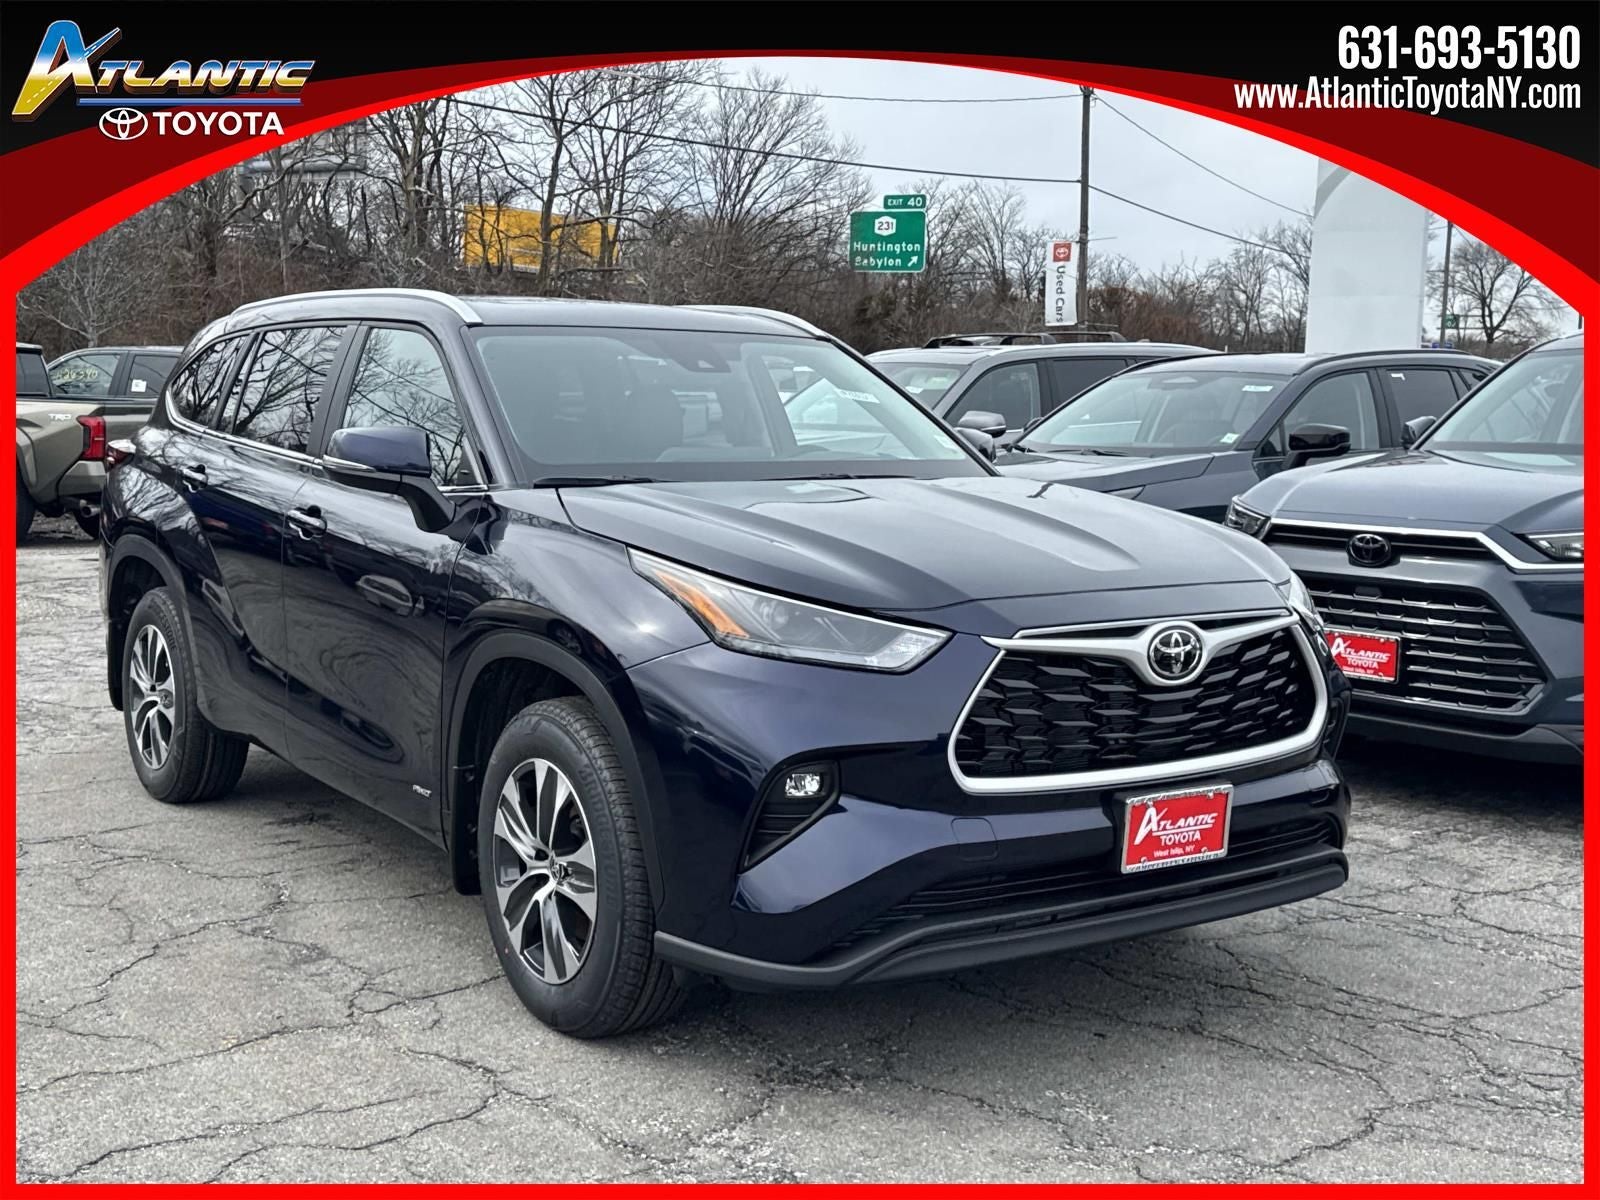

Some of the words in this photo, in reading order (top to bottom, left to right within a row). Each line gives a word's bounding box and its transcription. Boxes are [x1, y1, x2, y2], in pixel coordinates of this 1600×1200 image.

[887, 198, 903, 206] EXIT
[907, 196, 923, 207] 40
[877, 221, 894, 231] 231
[853, 241, 921, 255] Huntington
[854, 256, 902, 269] Babylon
[1055, 265, 1067, 295] Used
[1055, 297, 1066, 323] Cars
[48, 413, 72, 421] TRD
[1331, 637, 1391, 660] ATLANTIC
[1347, 658, 1379, 669] TOYOTA
[1134, 806, 1218, 845] ATLANTIC
[1160, 830, 1201, 846] TOYOTA
[1185, 844, 1196, 853] NY
